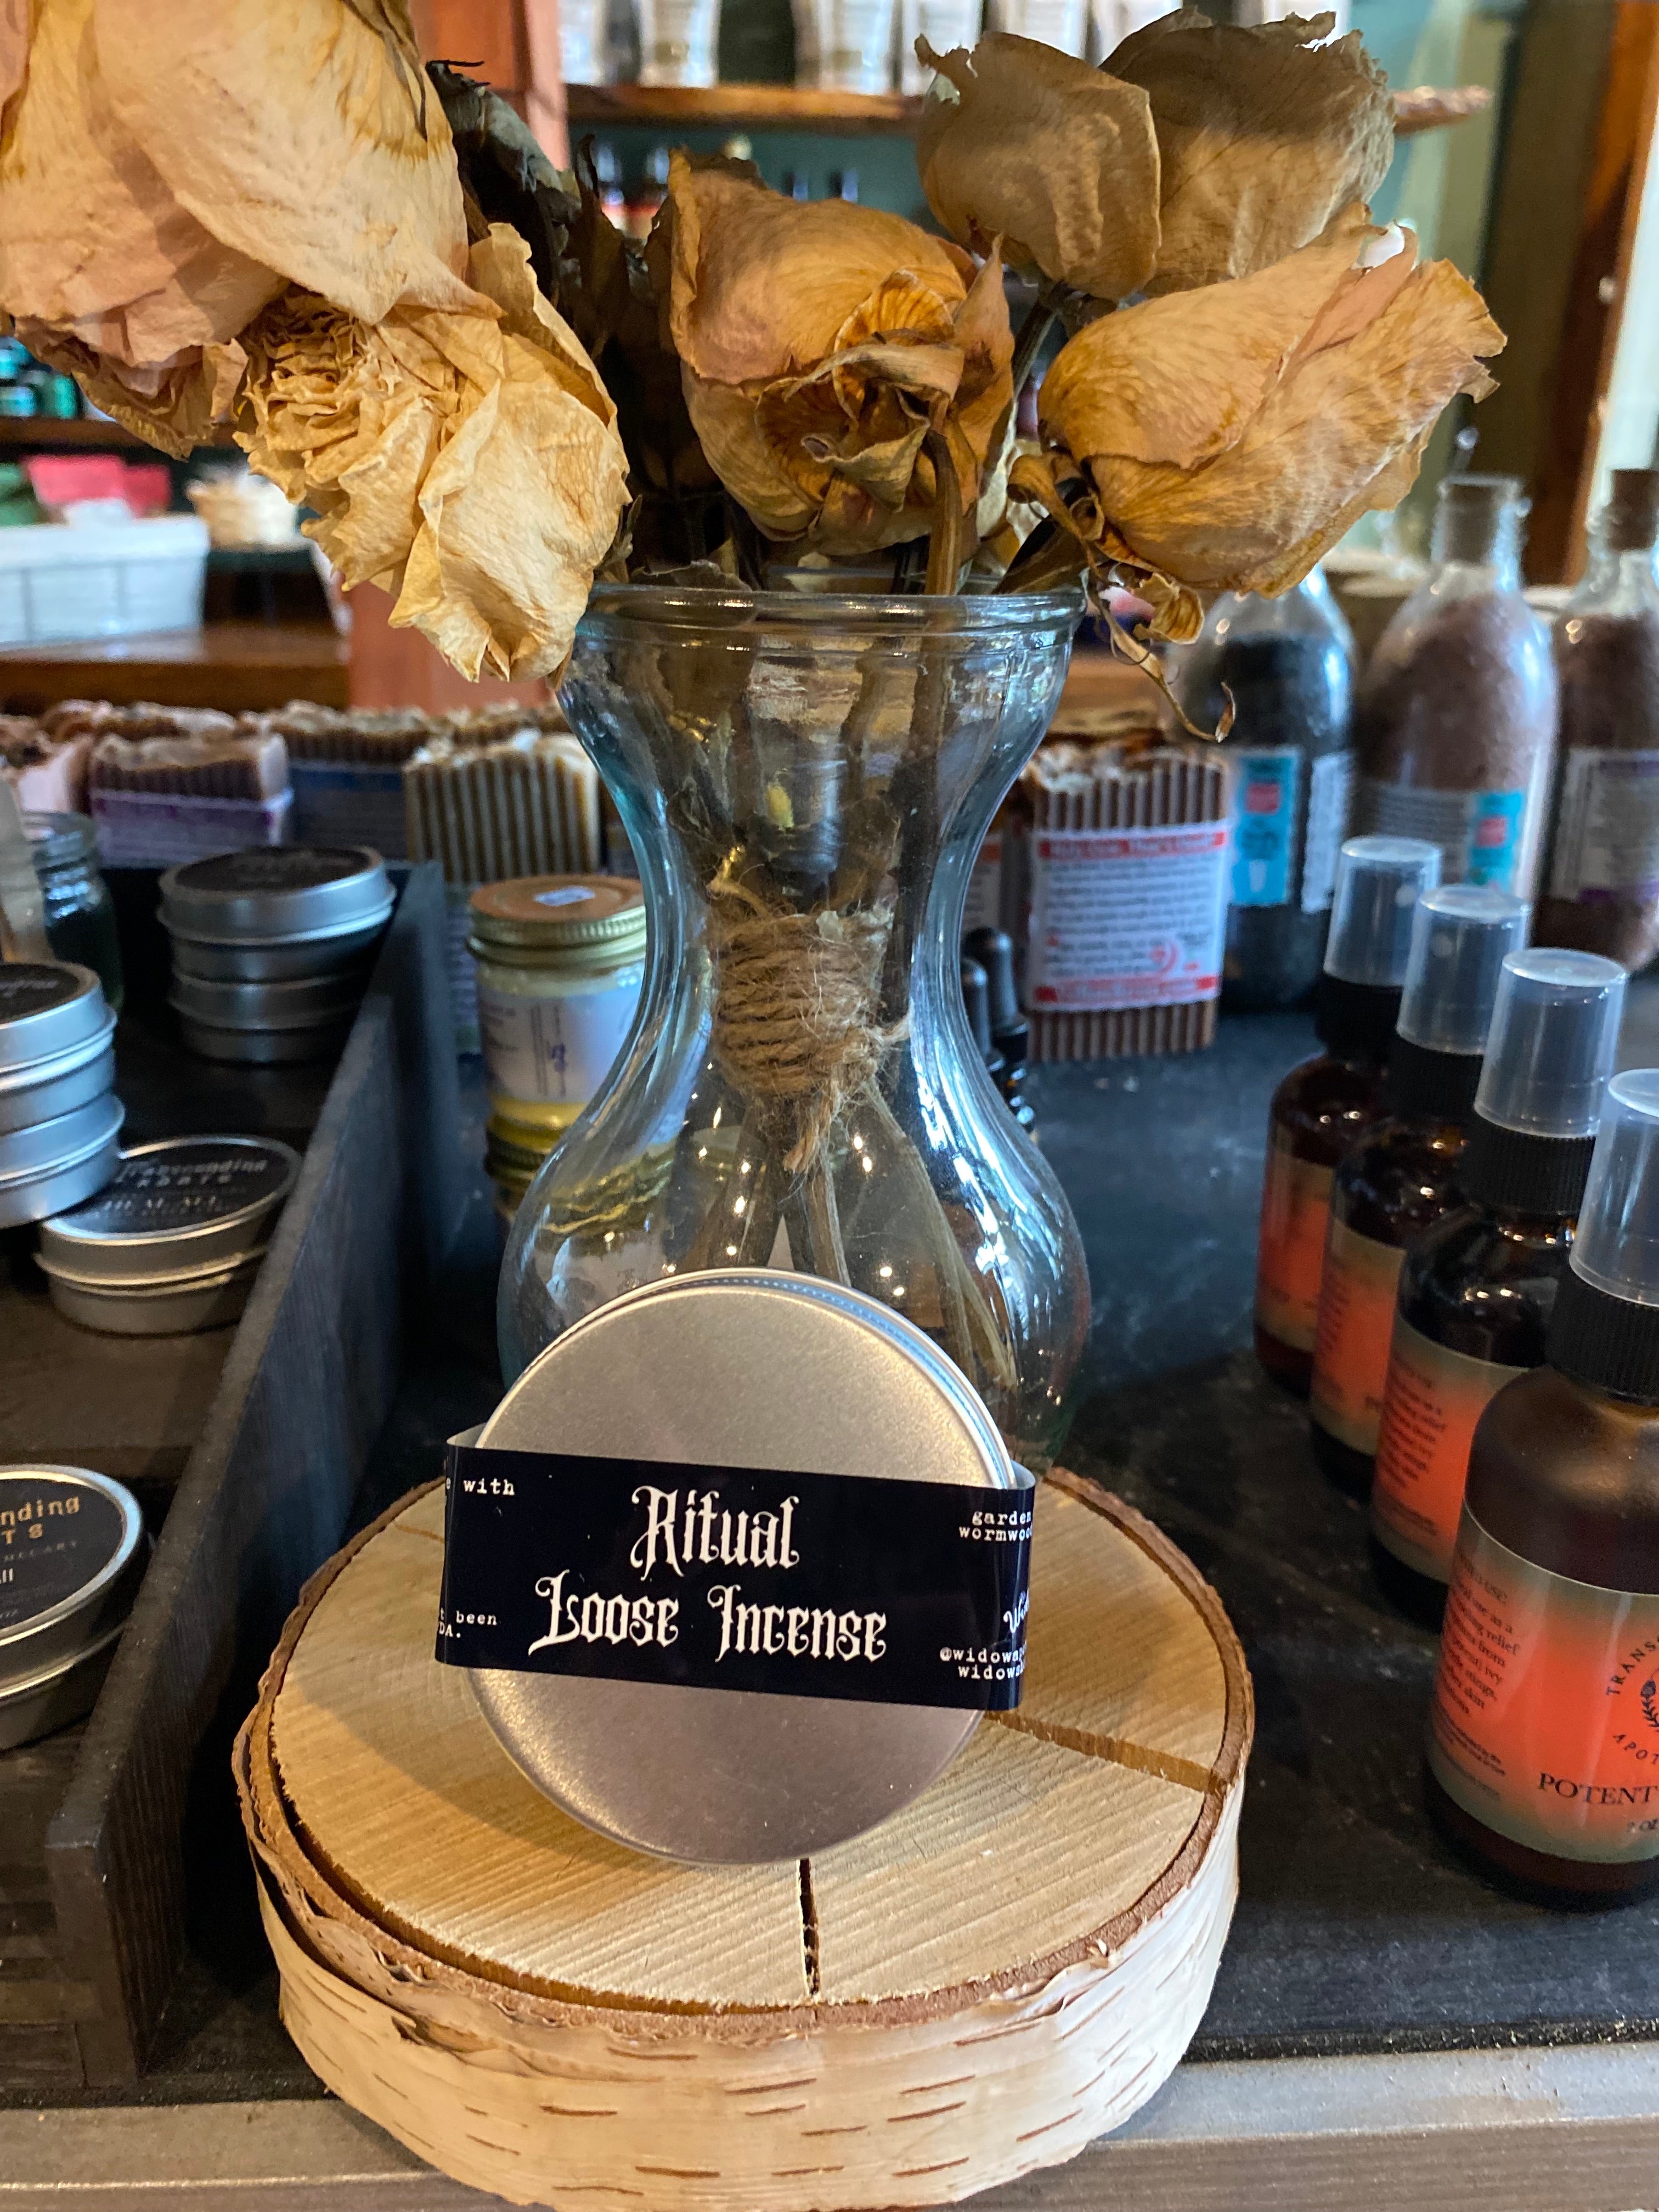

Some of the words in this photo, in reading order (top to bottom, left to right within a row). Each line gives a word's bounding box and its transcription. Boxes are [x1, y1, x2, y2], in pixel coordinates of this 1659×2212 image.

[464, 1477, 515, 1496] with
[630, 1485, 800, 1581] Ritual
[972, 1510, 1031, 1526] garden
[456, 1610, 498, 1626] been
[528, 1569, 679, 1656] Loose
[707, 1584, 887, 1663] Incense
[1606, 1636, 1659, 1696] TRANS
[1538, 1772, 1658, 1804] POTENT
